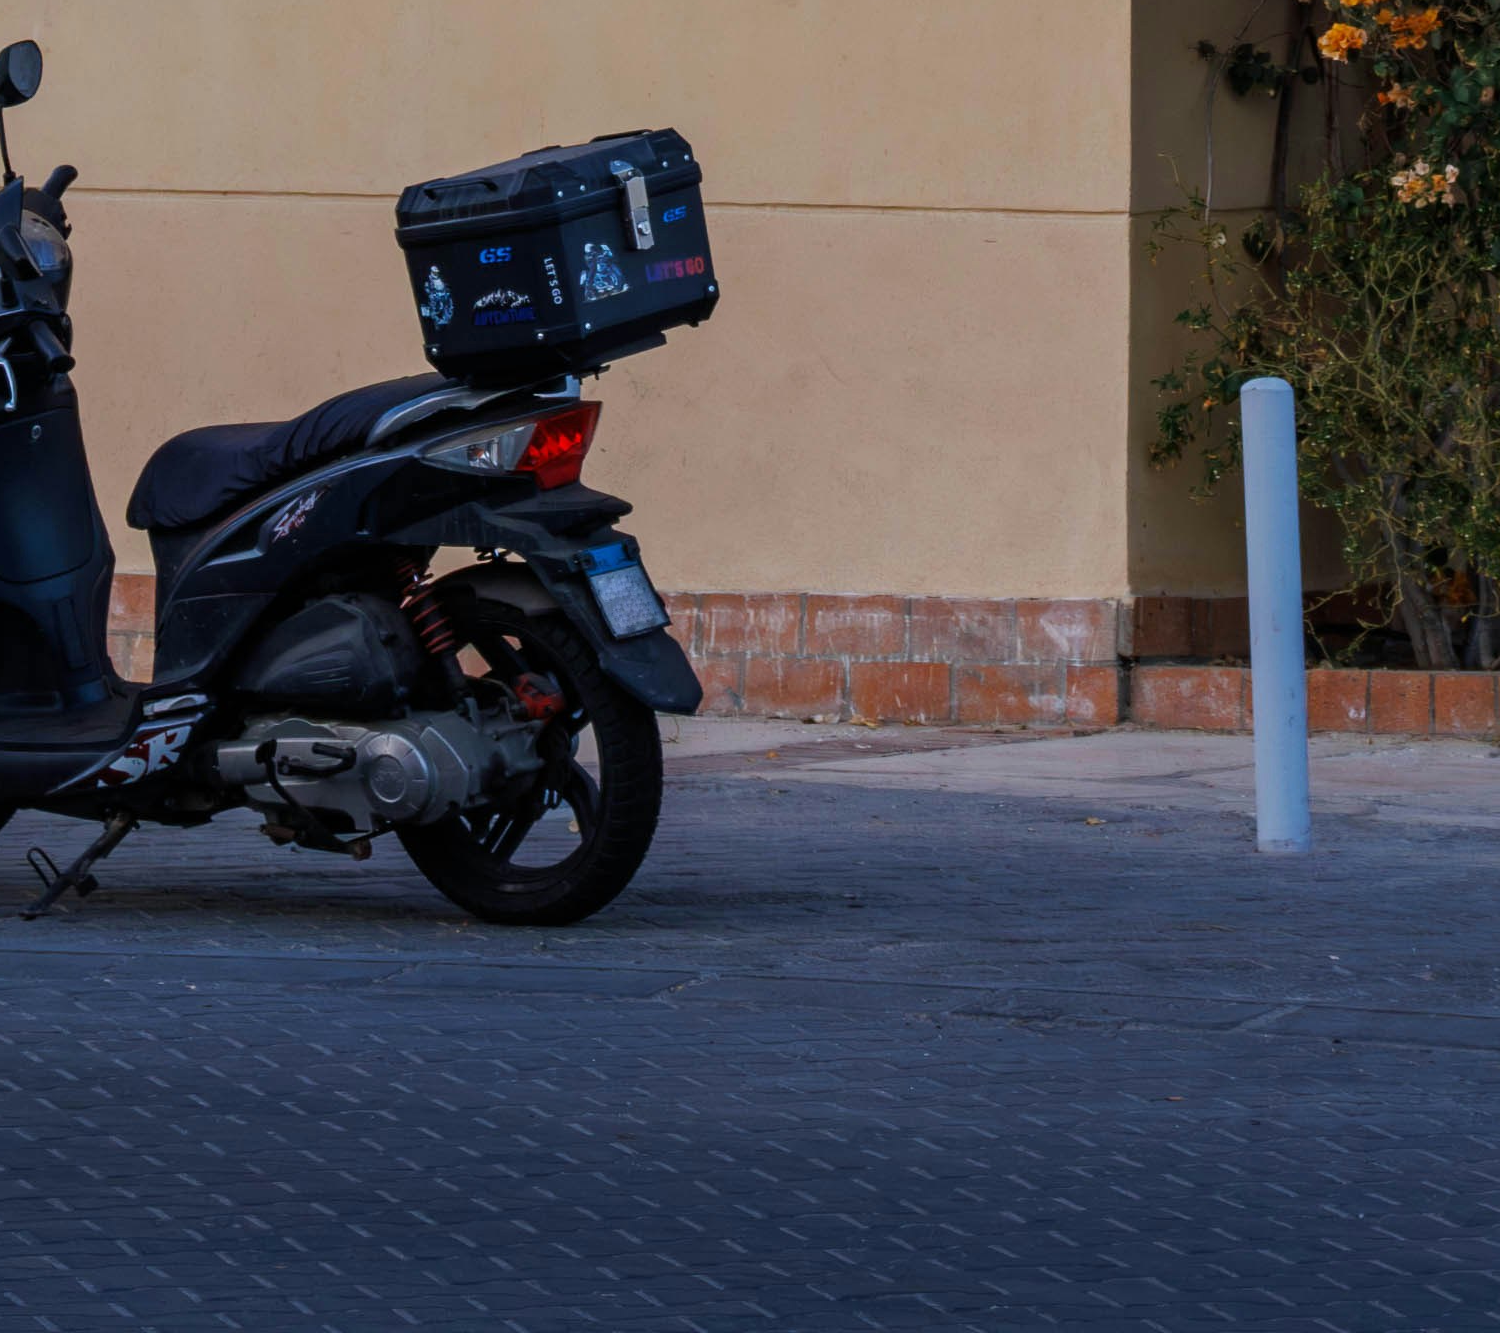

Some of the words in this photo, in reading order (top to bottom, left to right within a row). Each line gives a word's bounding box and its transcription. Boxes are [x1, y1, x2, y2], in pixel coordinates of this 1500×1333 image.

[663, 205, 687, 223] GS
[479, 246, 512, 264] GS
[685, 256, 705, 277] GO
[551, 288, 563, 305] GO
